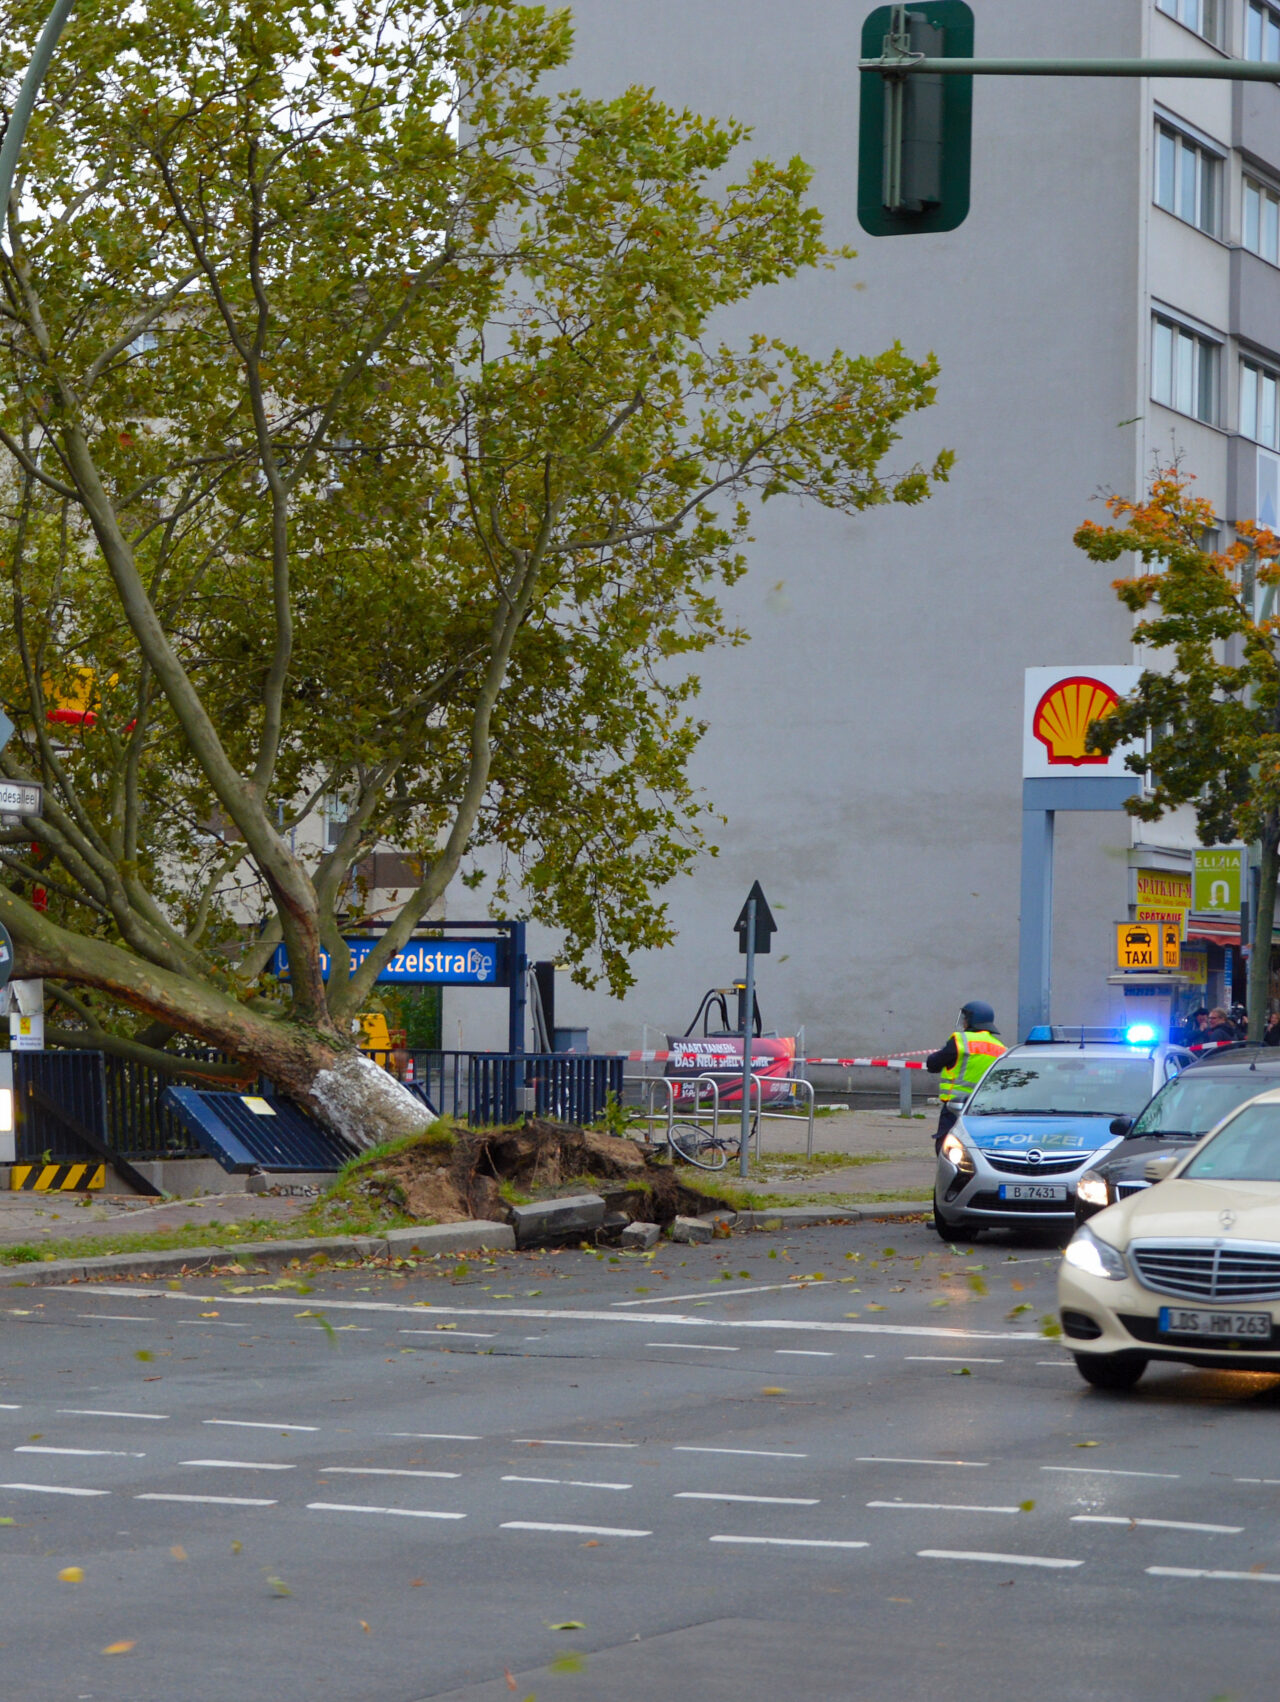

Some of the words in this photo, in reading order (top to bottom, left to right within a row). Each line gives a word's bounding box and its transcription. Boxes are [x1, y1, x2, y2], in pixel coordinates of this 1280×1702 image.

[1125, 951, 1153, 965] TAXI
[1165, 951, 1177, 965] TAXI
[674, 1055, 695, 1068] DAS
[993, 1133, 1084, 1147] POLIZEI
[1236, 1316, 1267, 1335] 263
